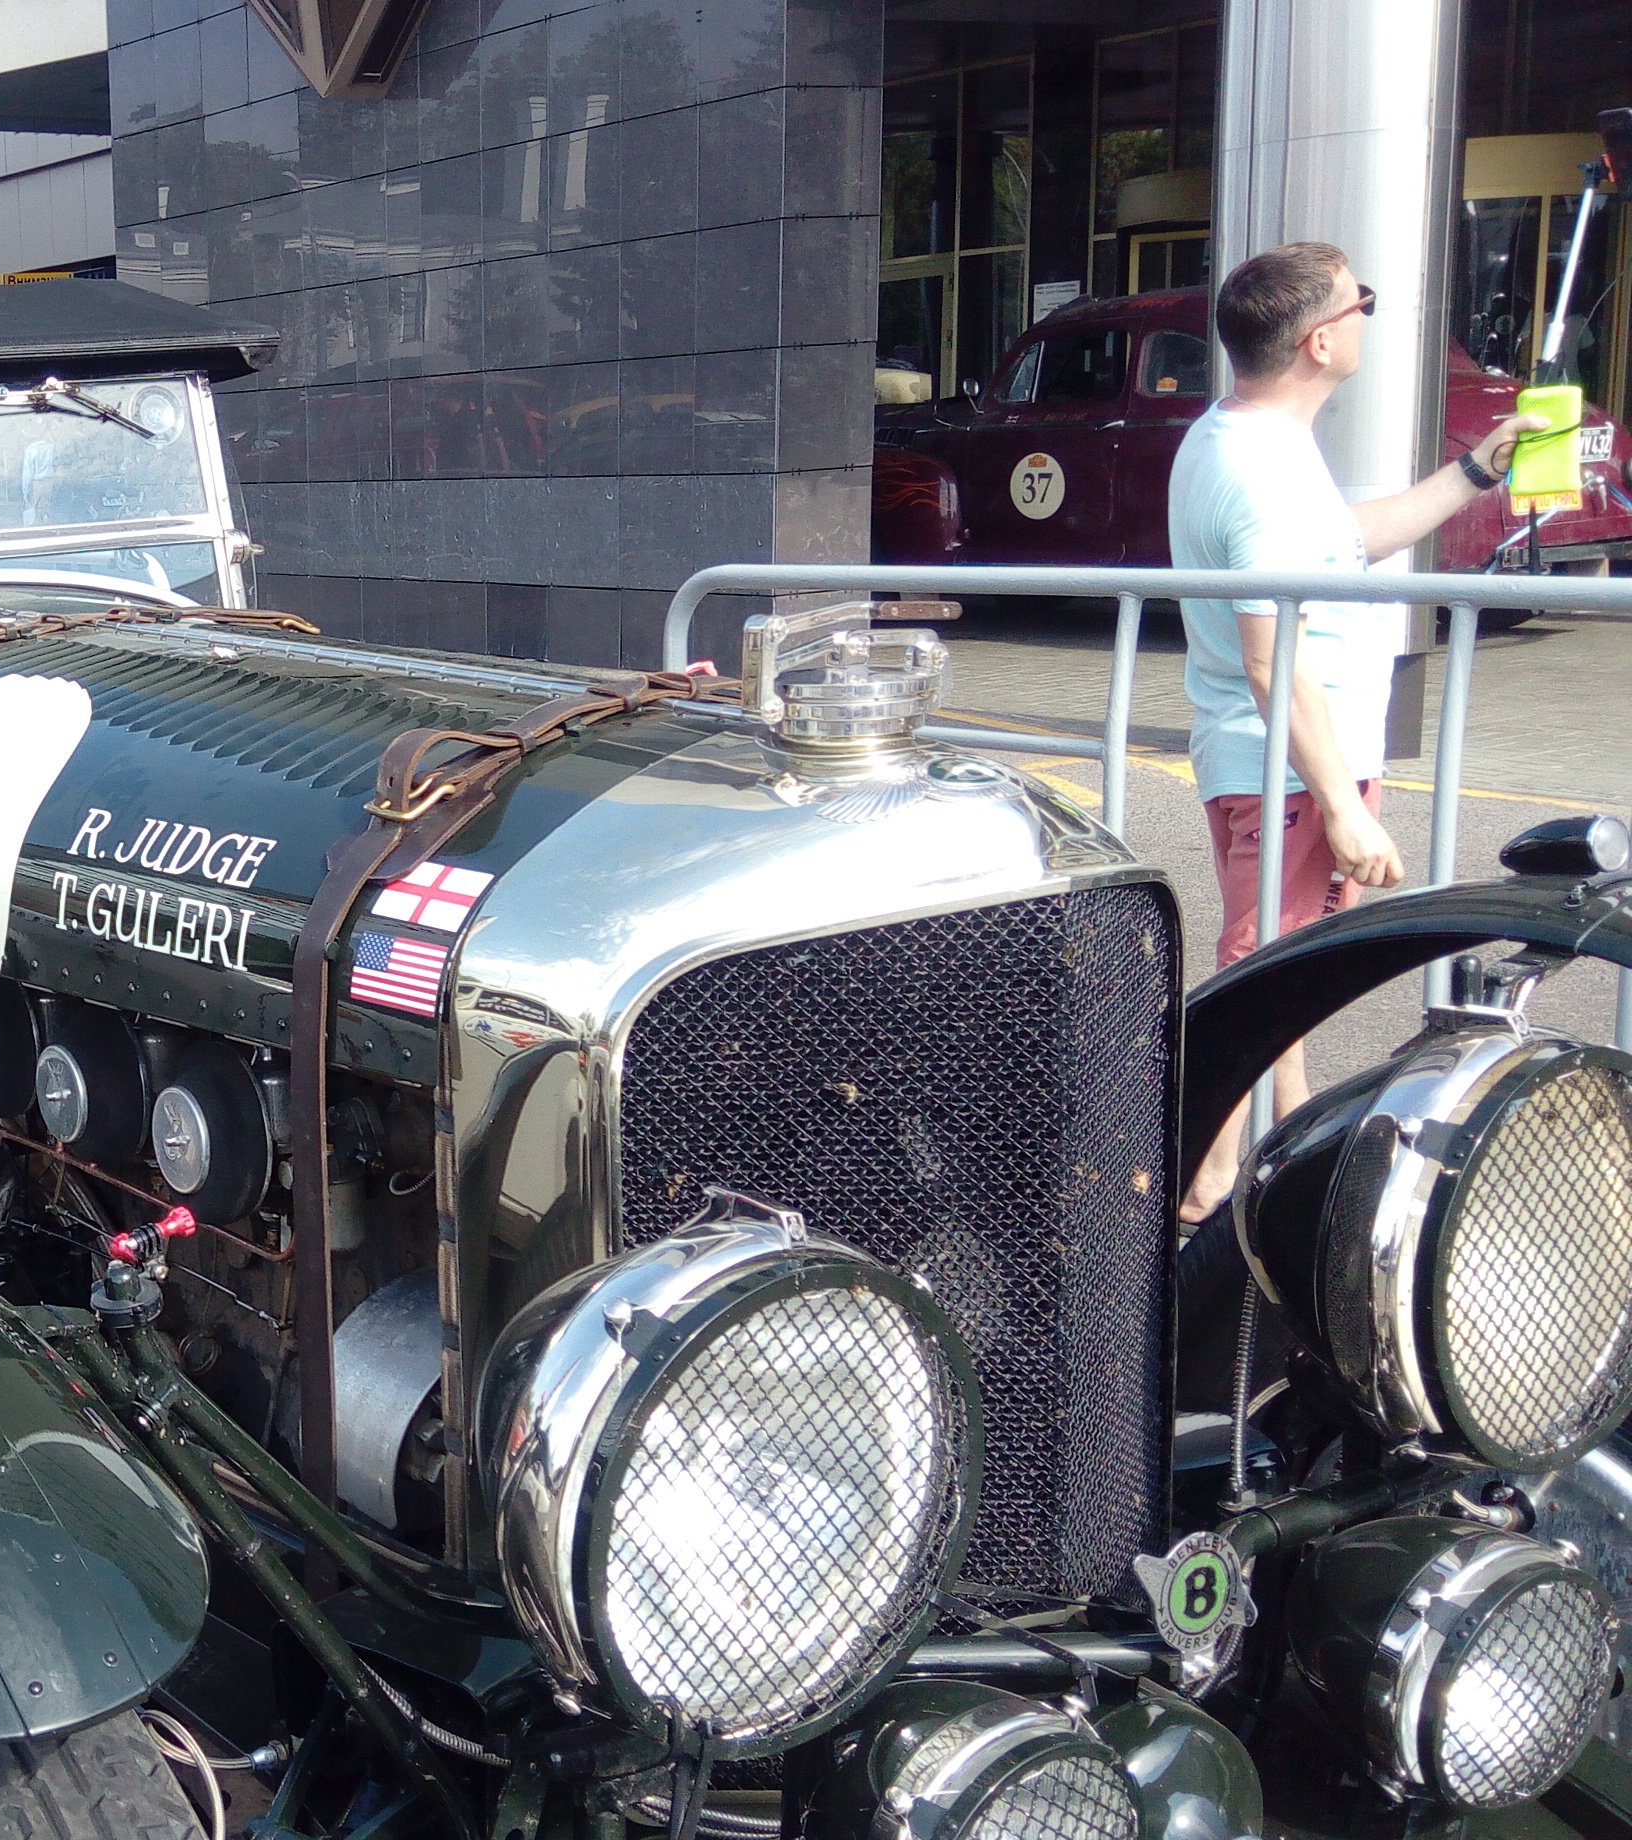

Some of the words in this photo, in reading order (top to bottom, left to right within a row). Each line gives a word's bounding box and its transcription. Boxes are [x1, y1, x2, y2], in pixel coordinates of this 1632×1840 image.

[1021, 472, 1053, 504] 37
[66, 807, 112, 860] R.
[114, 817, 278, 889] JUDGE
[52, 871, 79, 931] T.
[86, 882, 256, 972] GULERI
[1321, 883, 1344, 918] WEA
[1168, 1536, 1228, 1570] BENTLEY
[1184, 1565, 1217, 1619] B
[1159, 1619, 1210, 1650] DRIVERS
[1213, 1597, 1237, 1635] CLUB
